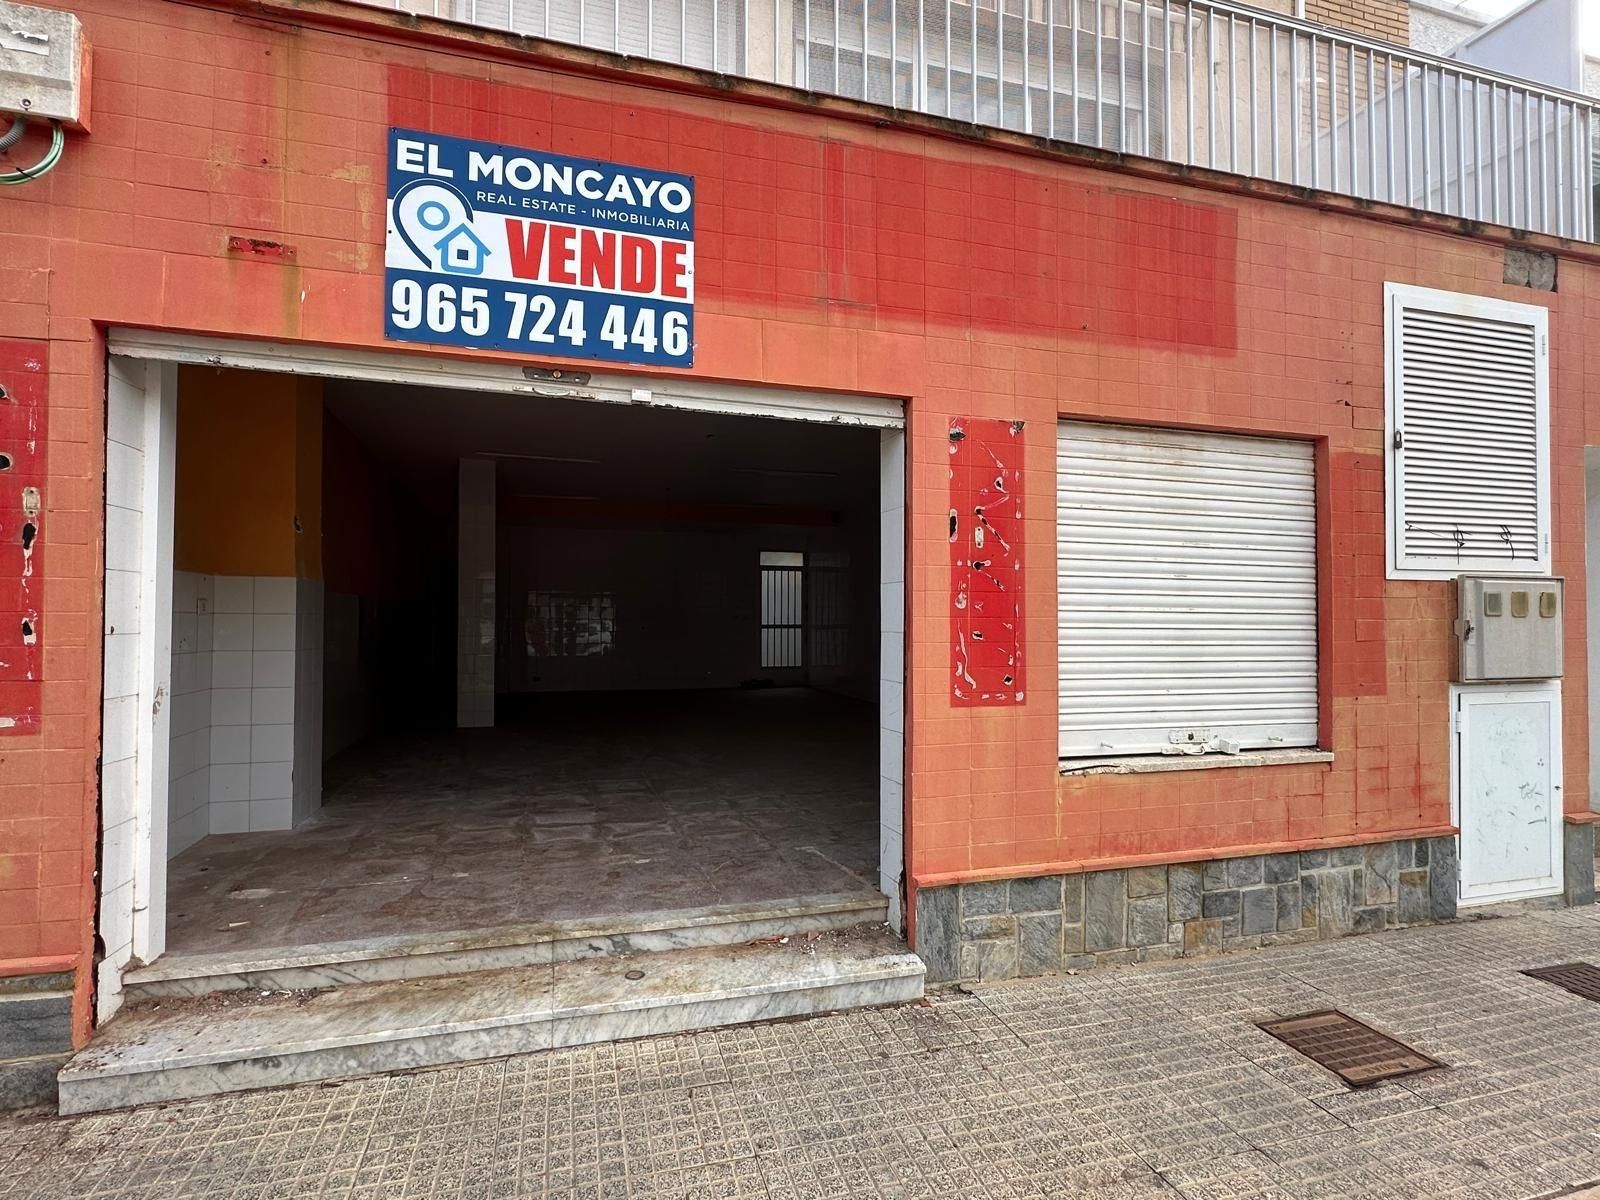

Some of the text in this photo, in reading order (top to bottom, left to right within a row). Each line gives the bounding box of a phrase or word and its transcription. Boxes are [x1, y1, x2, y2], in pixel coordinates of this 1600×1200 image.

[396, 138, 692, 214] EL MONCAYO
[476, 191, 516, 206] REAL
[522, 196, 576, 215] ESTATE
[591, 207, 690, 232] INMOBILIARIA
[504, 217, 688, 299] VENDE
[391, 278, 689, 356] 965 724 446
